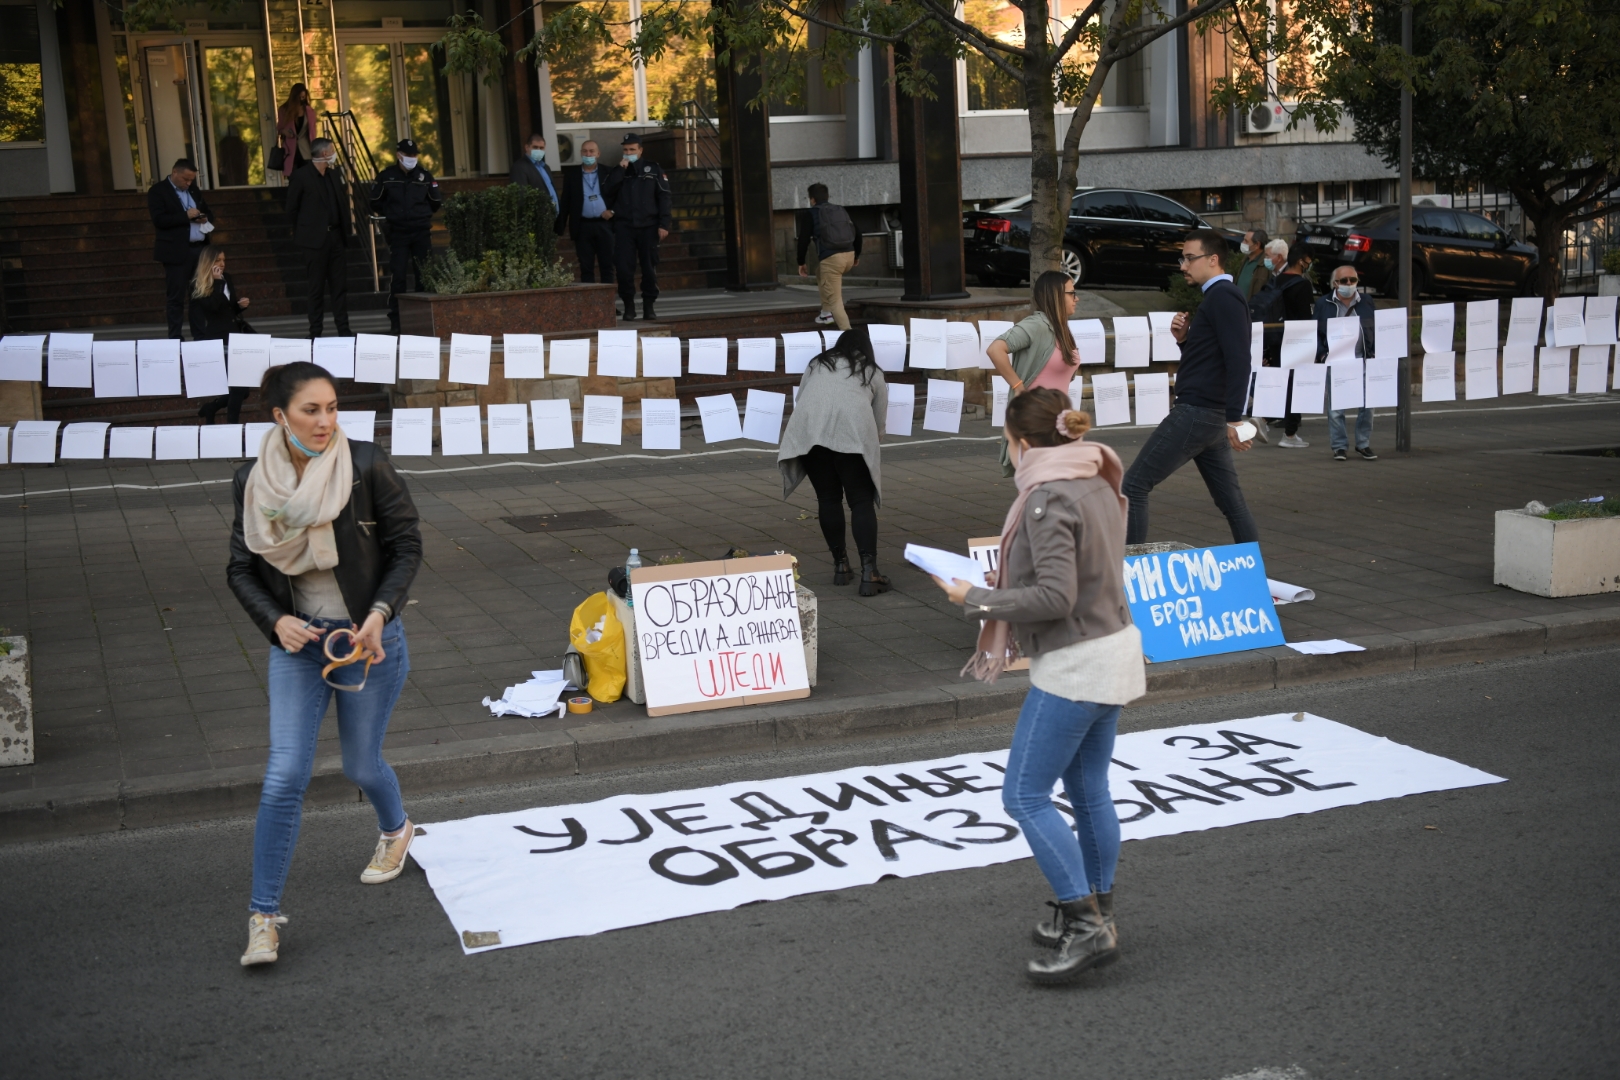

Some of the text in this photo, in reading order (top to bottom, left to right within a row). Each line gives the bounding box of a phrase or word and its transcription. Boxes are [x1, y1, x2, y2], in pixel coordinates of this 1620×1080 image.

[1123, 549, 1256, 604] МИ СМО САМО
[644, 574, 797, 627] ОБРАЗОВАЊЕ
[1150, 596, 1203, 627] БРОЈ
[717, 623, 731, 650] А
[733, 618, 799, 647] ДРЖАВА
[1179, 607, 1275, 648] ИНДЕКСА
[694, 651, 786, 698] ШТЕДИ
[513, 729, 1303, 854] УЈЕДИЊЕ ЗА
